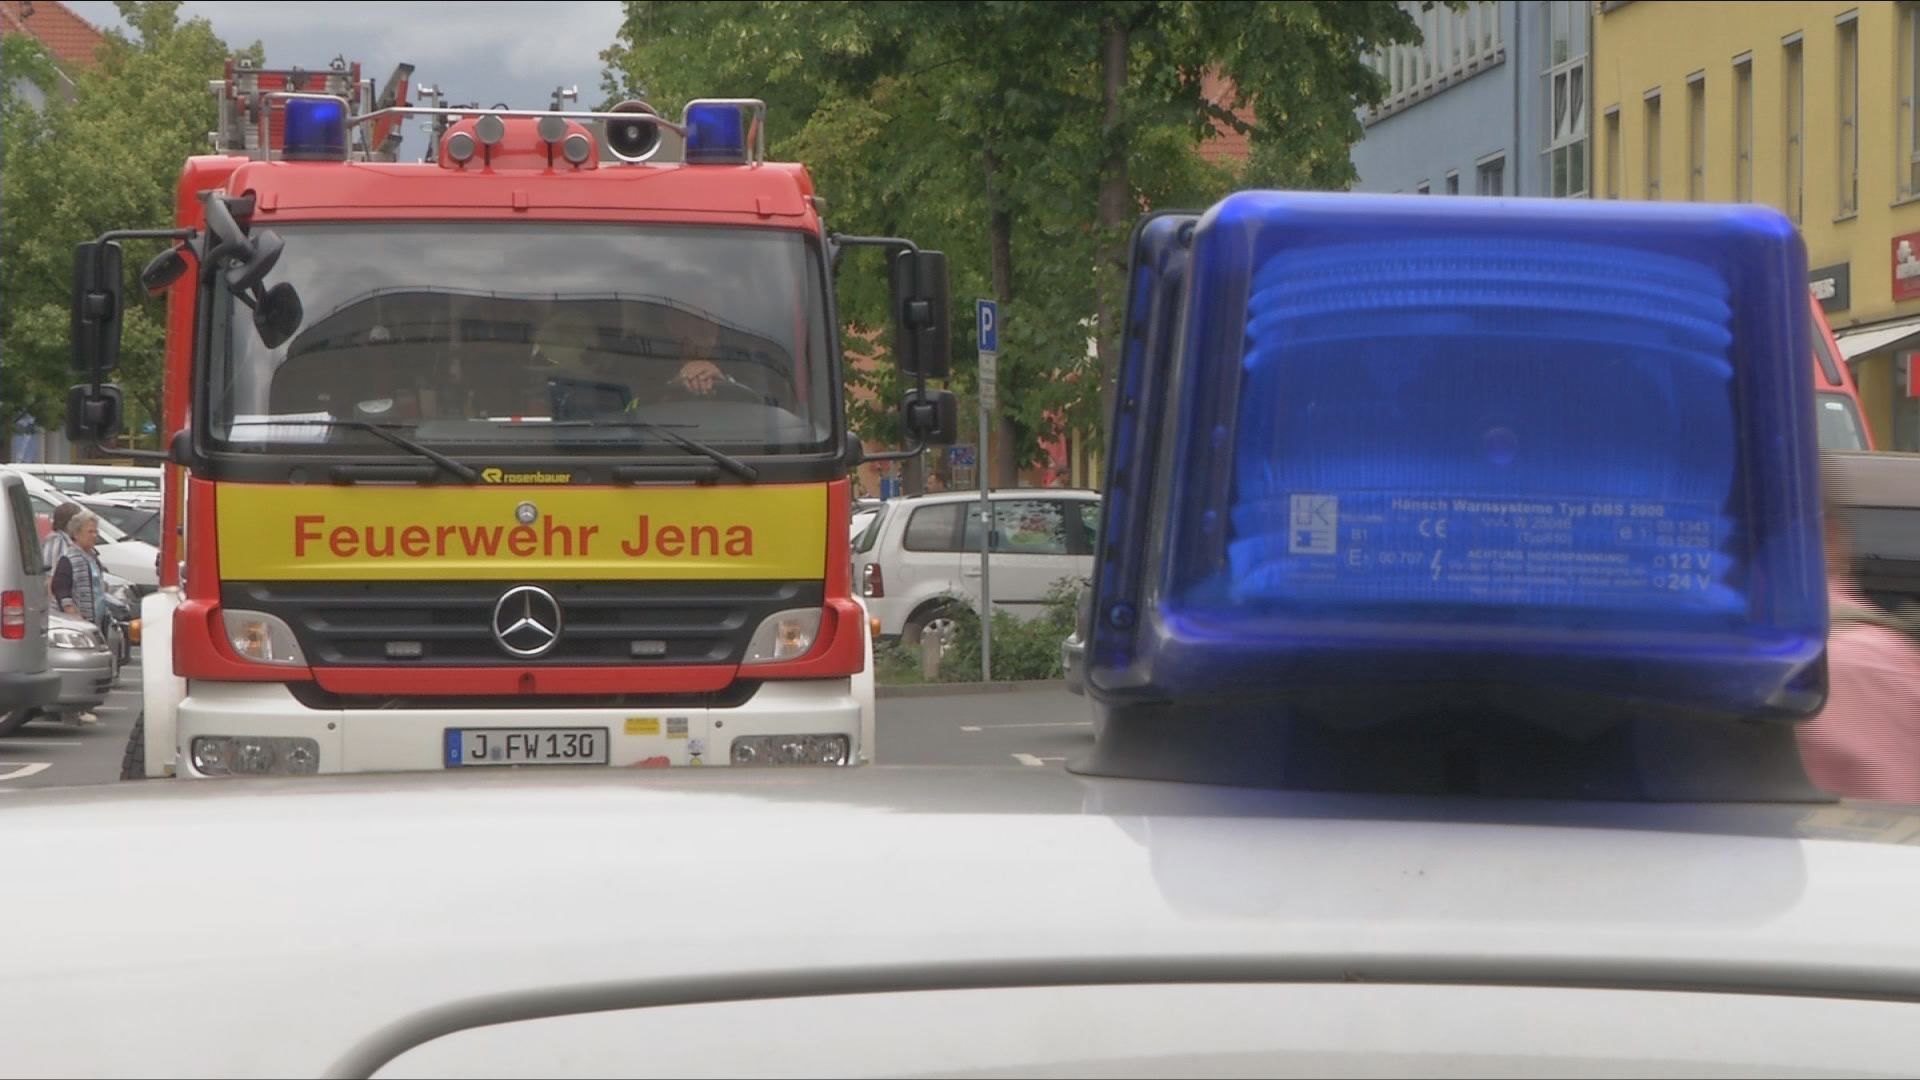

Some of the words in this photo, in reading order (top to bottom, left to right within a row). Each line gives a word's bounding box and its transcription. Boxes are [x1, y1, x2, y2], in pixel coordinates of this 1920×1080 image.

[982, 306, 993, 345] P
[503, 471, 571, 483] rosenbauer
[1391, 498, 1448, 511] Hänsch
[1452, 499, 1553, 515] Warnsysteme
[1560, 502, 1586, 517] Typ
[1591, 504, 1624, 517] DBS
[295, 515, 599, 557] Feuerwehr
[621, 515, 753, 556] Jena
[1669, 553, 1692, 569] 12
[1696, 553, 1712, 569] V
[1668, 574, 1692, 590] 24
[1696, 574, 1711, 591] V
[472, 734, 488, 759] J
[507, 734, 540, 759] FW
[546, 734, 595, 758] 130
